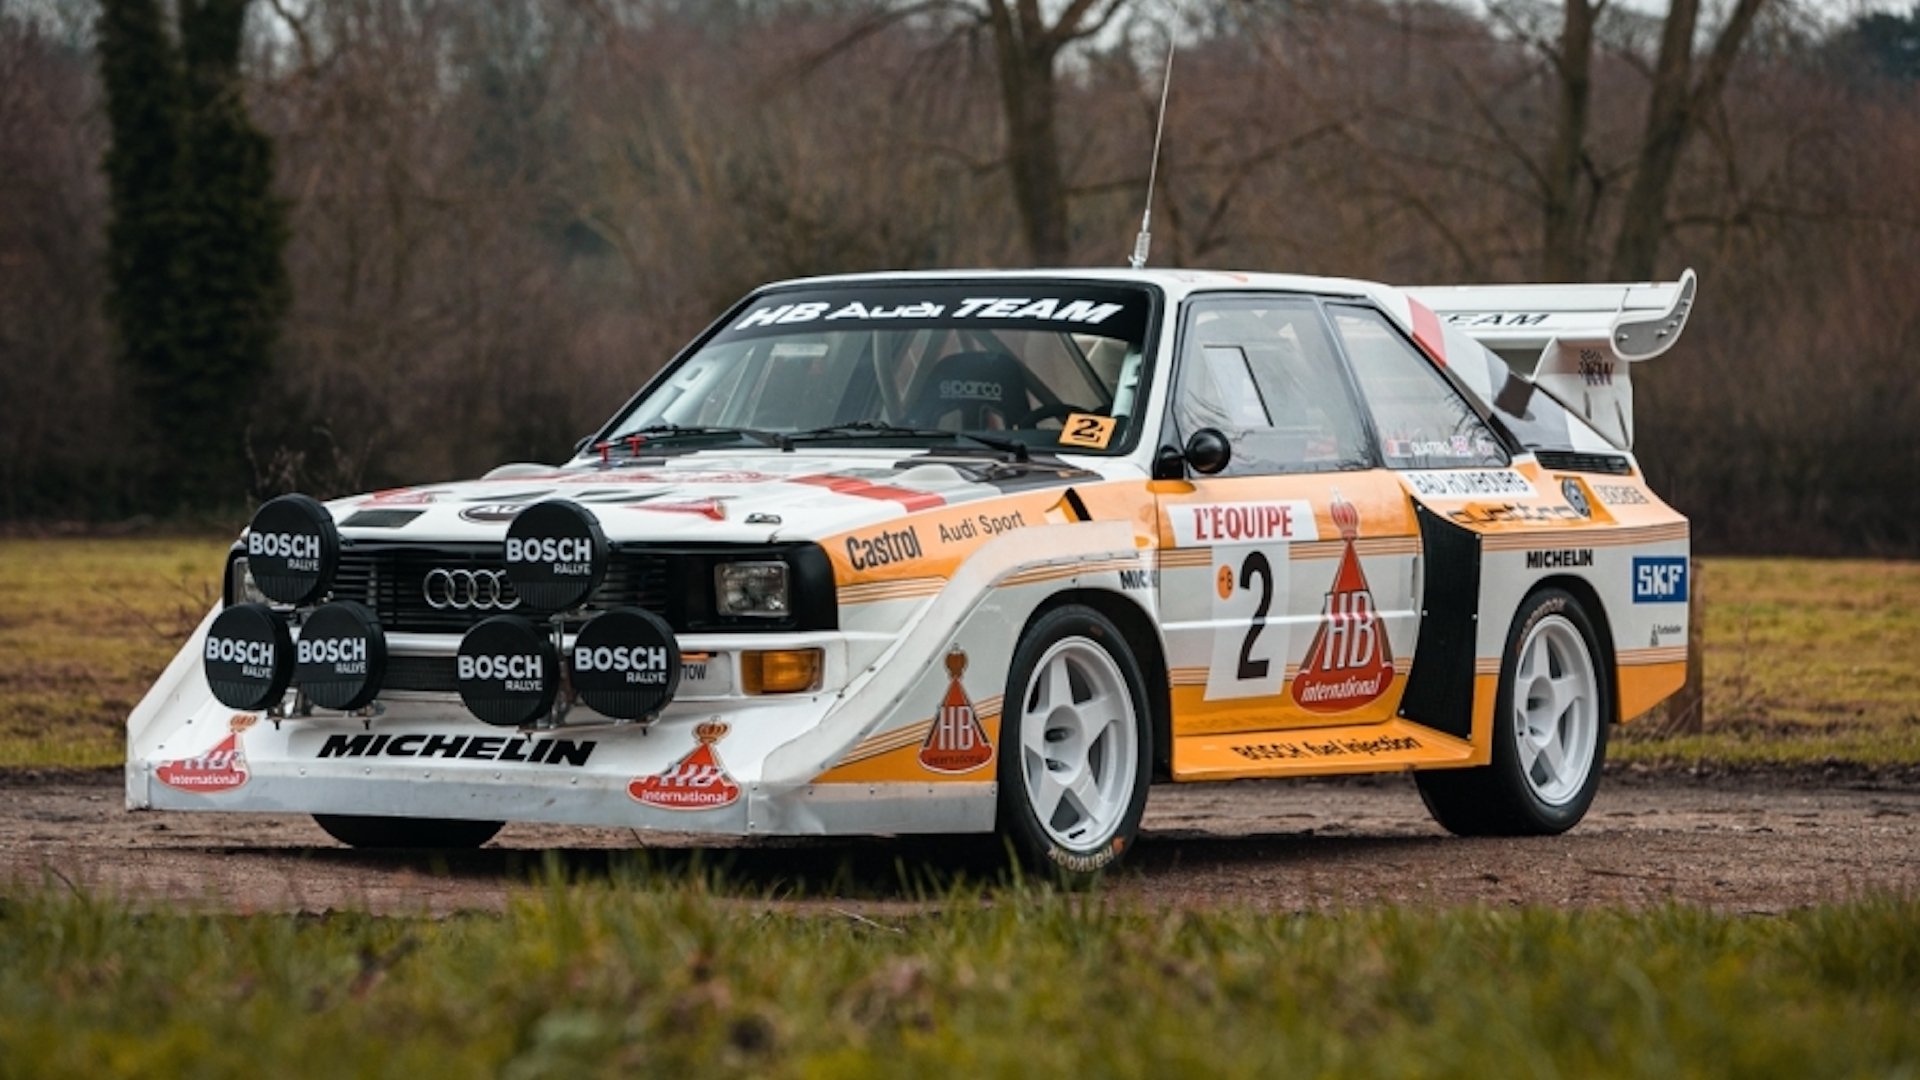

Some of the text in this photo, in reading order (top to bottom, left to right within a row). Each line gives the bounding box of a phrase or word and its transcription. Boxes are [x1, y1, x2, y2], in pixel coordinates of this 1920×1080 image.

[735, 298, 1123, 330] HB Audi TEAM
[1447, 312, 1550, 327] EAM
[939, 379, 1001, 398] sparco
[938, 510, 1026, 544] Audi Sport
[247, 532, 320, 558] BOSCH
[506, 537, 591, 562] BOSCH
[845, 526, 922, 572] Castrol
[287, 557, 320, 571] RALLYE
[553, 563, 591, 575] RALLYE
[1526, 549, 1593, 569] MICHELIN
[1637, 564, 1683, 596] SKF
[1237, 550, 1273, 680] 2
[1321, 592, 1376, 670] HB
[206, 637, 274, 665] BOSCH
[300, 636, 366, 662] BOSCH
[574, 645, 667, 671] BOSCH
[241, 664, 272, 678] RALLYE
[335, 661, 366, 674] RALLYE
[458, 654, 543, 679] BOSCH
[626, 670, 666, 684] RALLYE
[680, 663, 707, 680] TOW
[505, 679, 543, 691] RALLYE
[1302, 674, 1381, 701] international
[938, 706, 975, 750] HB
[316, 734, 597, 766] MICHELIN
[169, 772, 240, 786] international
[641, 789, 729, 803] international
